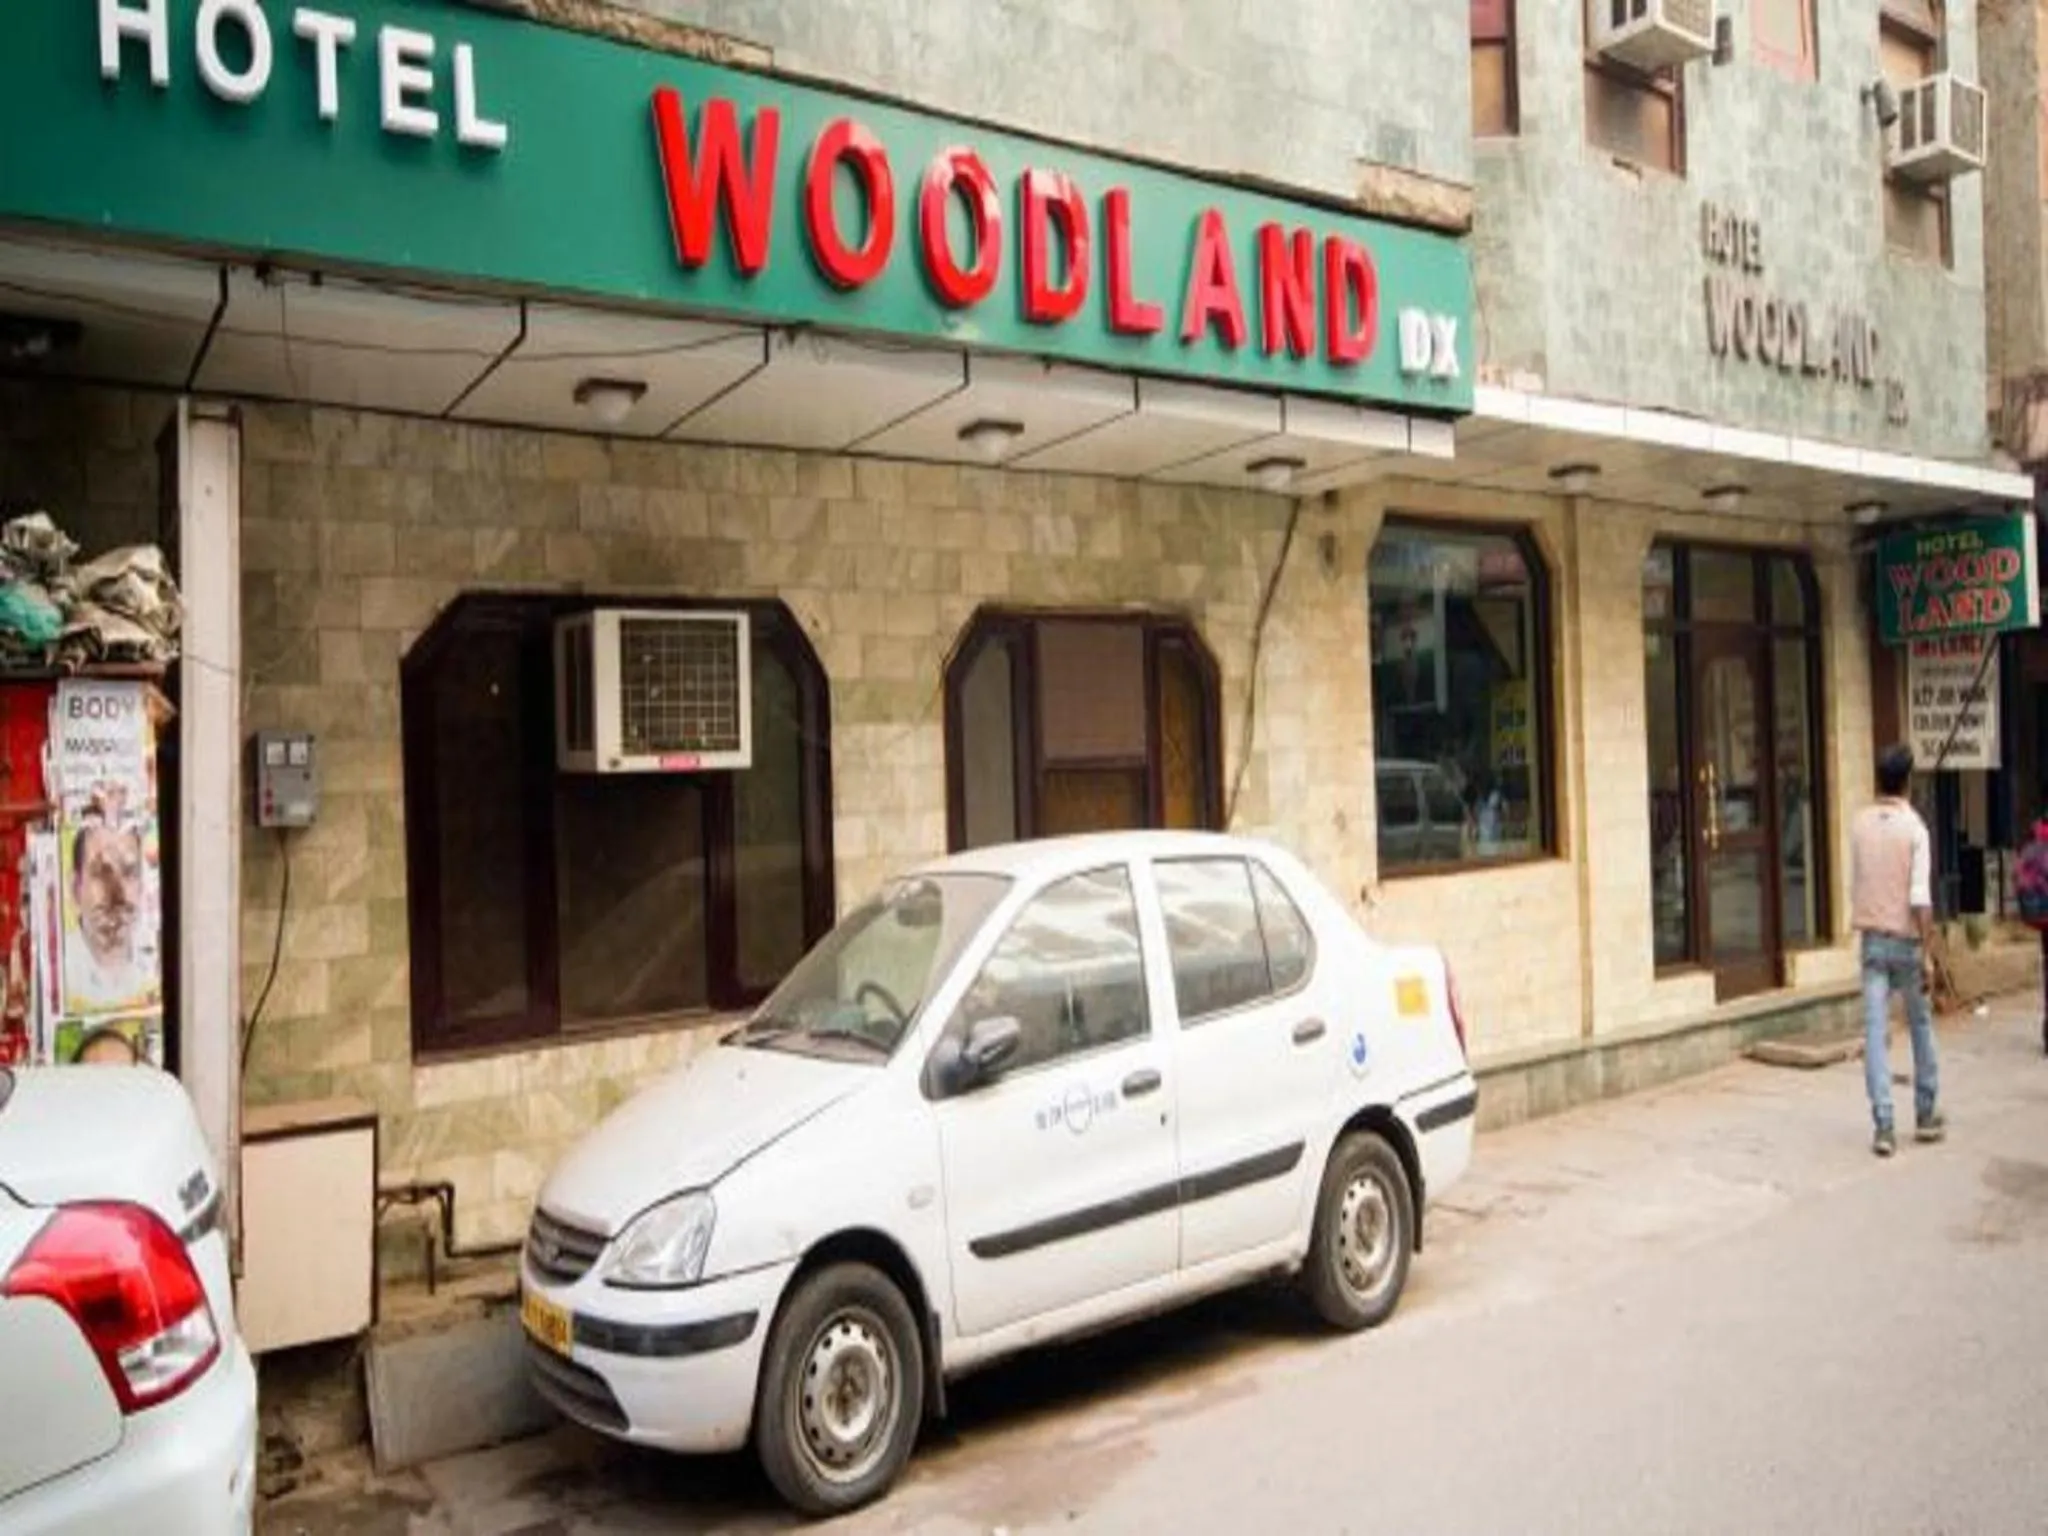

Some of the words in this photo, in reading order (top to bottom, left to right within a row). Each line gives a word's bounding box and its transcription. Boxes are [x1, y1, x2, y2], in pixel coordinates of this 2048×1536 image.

[100, 0, 506, 148] HOTEL
[652, 86, 1378, 365] WOODLAND
[1398, 308, 1460, 378] DX
[1700, 200, 1762, 276] HOTEL
[1702, 272, 1880, 388] WOODLAND
[1916, 529, 1984, 557] HOTEL
[1887, 547, 2020, 590] WOOD
[1897, 587, 2012, 634] LAND
[68, 696, 135, 719] BODY
